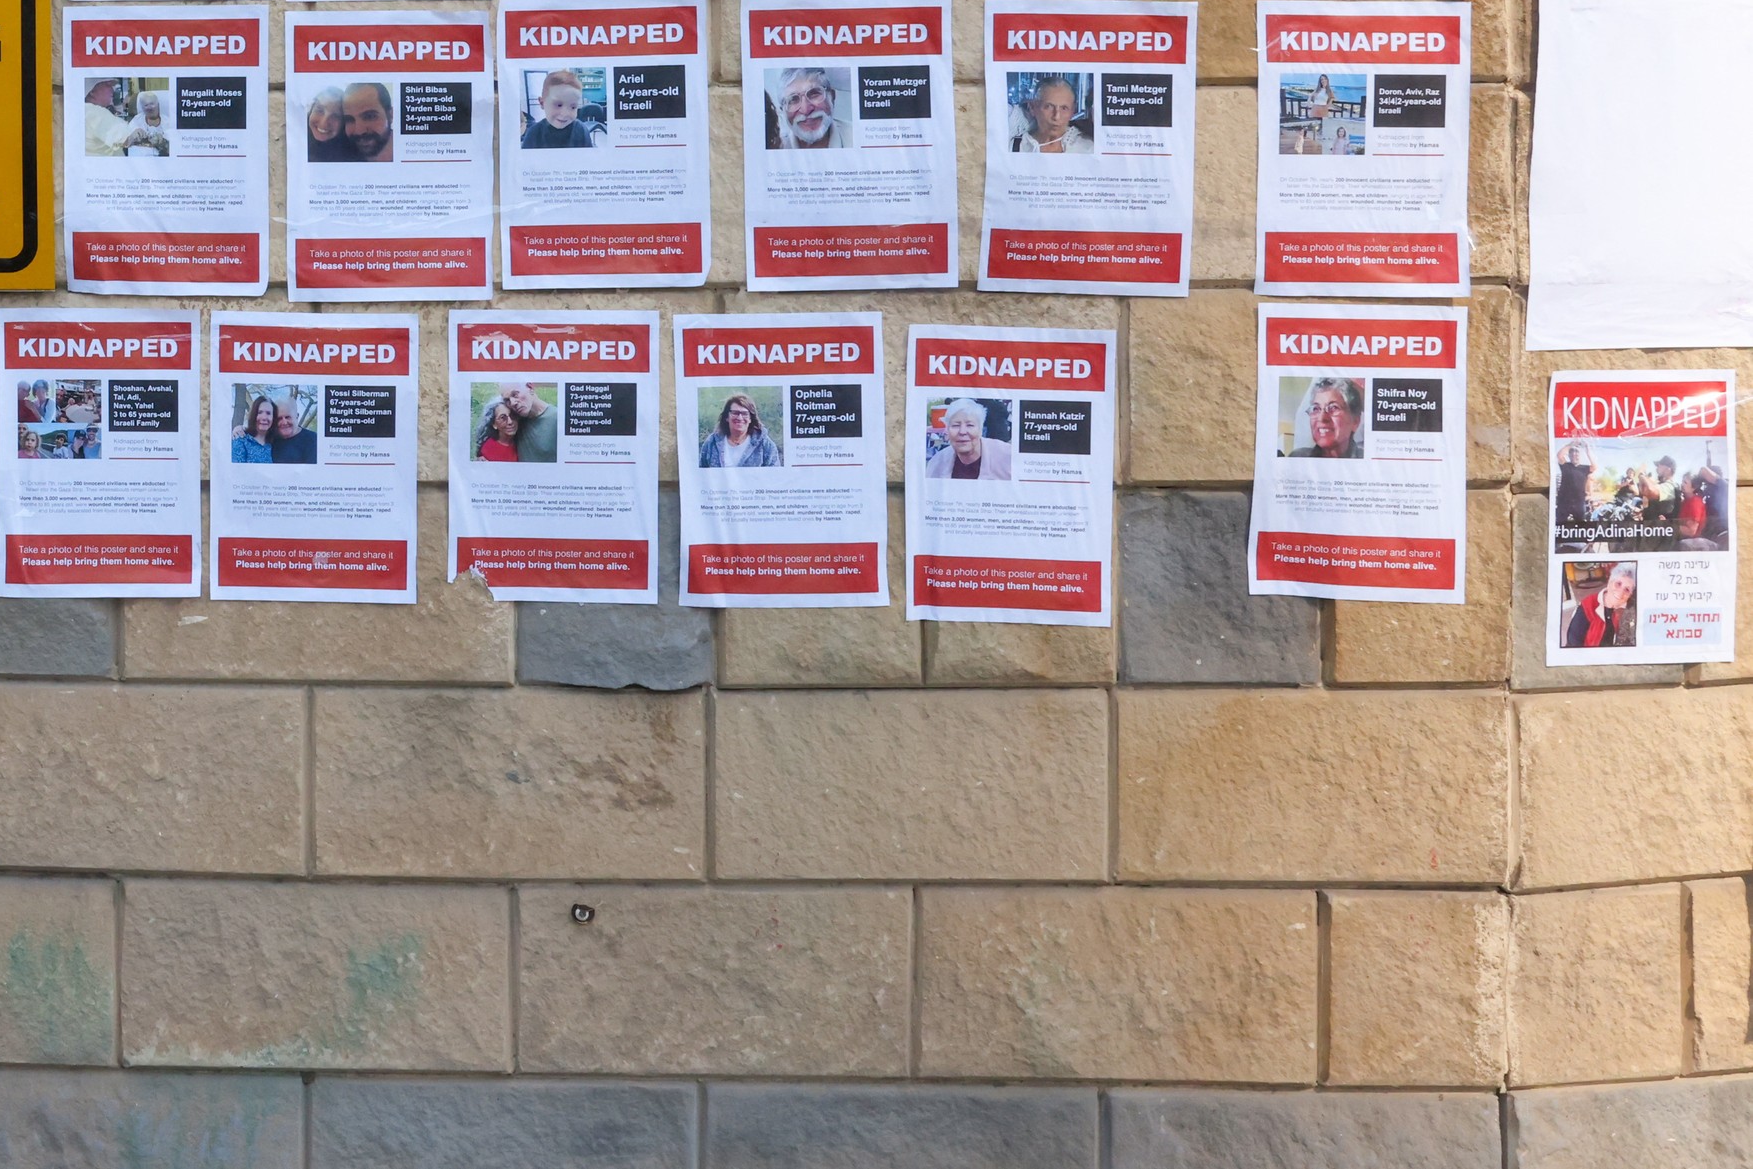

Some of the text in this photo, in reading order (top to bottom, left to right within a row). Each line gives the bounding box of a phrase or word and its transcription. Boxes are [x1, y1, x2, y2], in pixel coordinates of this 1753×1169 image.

[519, 24, 684, 47] KIDNAPPED
[763, 24, 928, 46] KIDNAPPED
[85, 36, 246, 56] KIDNAPPED
[1007, 31, 1173, 52] KIDNAPPED
[1280, 32, 1446, 52] KIDNAPPED
[308, 42, 471, 61] KIDNAPPED
[619, 74, 643, 83] Ariel
[619, 86, 678, 99] 4-years-old
[1106, 84, 1167, 95] Tami Metzger
[620, 101, 651, 110] Israeli
[1107, 96, 1162, 106] 78-years-old
[1107, 107, 1134, 115] Israeli
[18, 339, 178, 358] KIDNAPPED
[471, 340, 636, 362] KIDNAPPED
[1279, 334, 1443, 356] KIDNAPPED
[233, 342, 396, 364] KIDNAPPED
[697, 343, 860, 365] KIDNAPPED
[928, 355, 1091, 379] KIDNAPPED
[796, 390, 832, 399] Ophelia
[1378, 389, 1427, 399] Shifra Noy
[796, 402, 836, 410] Roitman
[1377, 401, 1436, 411] 70-years-old
[796, 413, 855, 424] 77-years-old
[1377, 413, 1406, 421] Israeli
[1562, 396, 1721, 430] KIDNAPPED
[796, 426, 825, 434] Israeli
[1555, 523, 1674, 542] #bringAdinaHome
[1658, 560, 1710, 570] עדינה משה
[1669, 573, 1699, 585] בת 72
[1655, 591, 1713, 603] קיבוץ ניר עוז
[1649, 613, 1720, 624] תחזרי אלינו
[1665, 628, 1703, 639] סבתא
